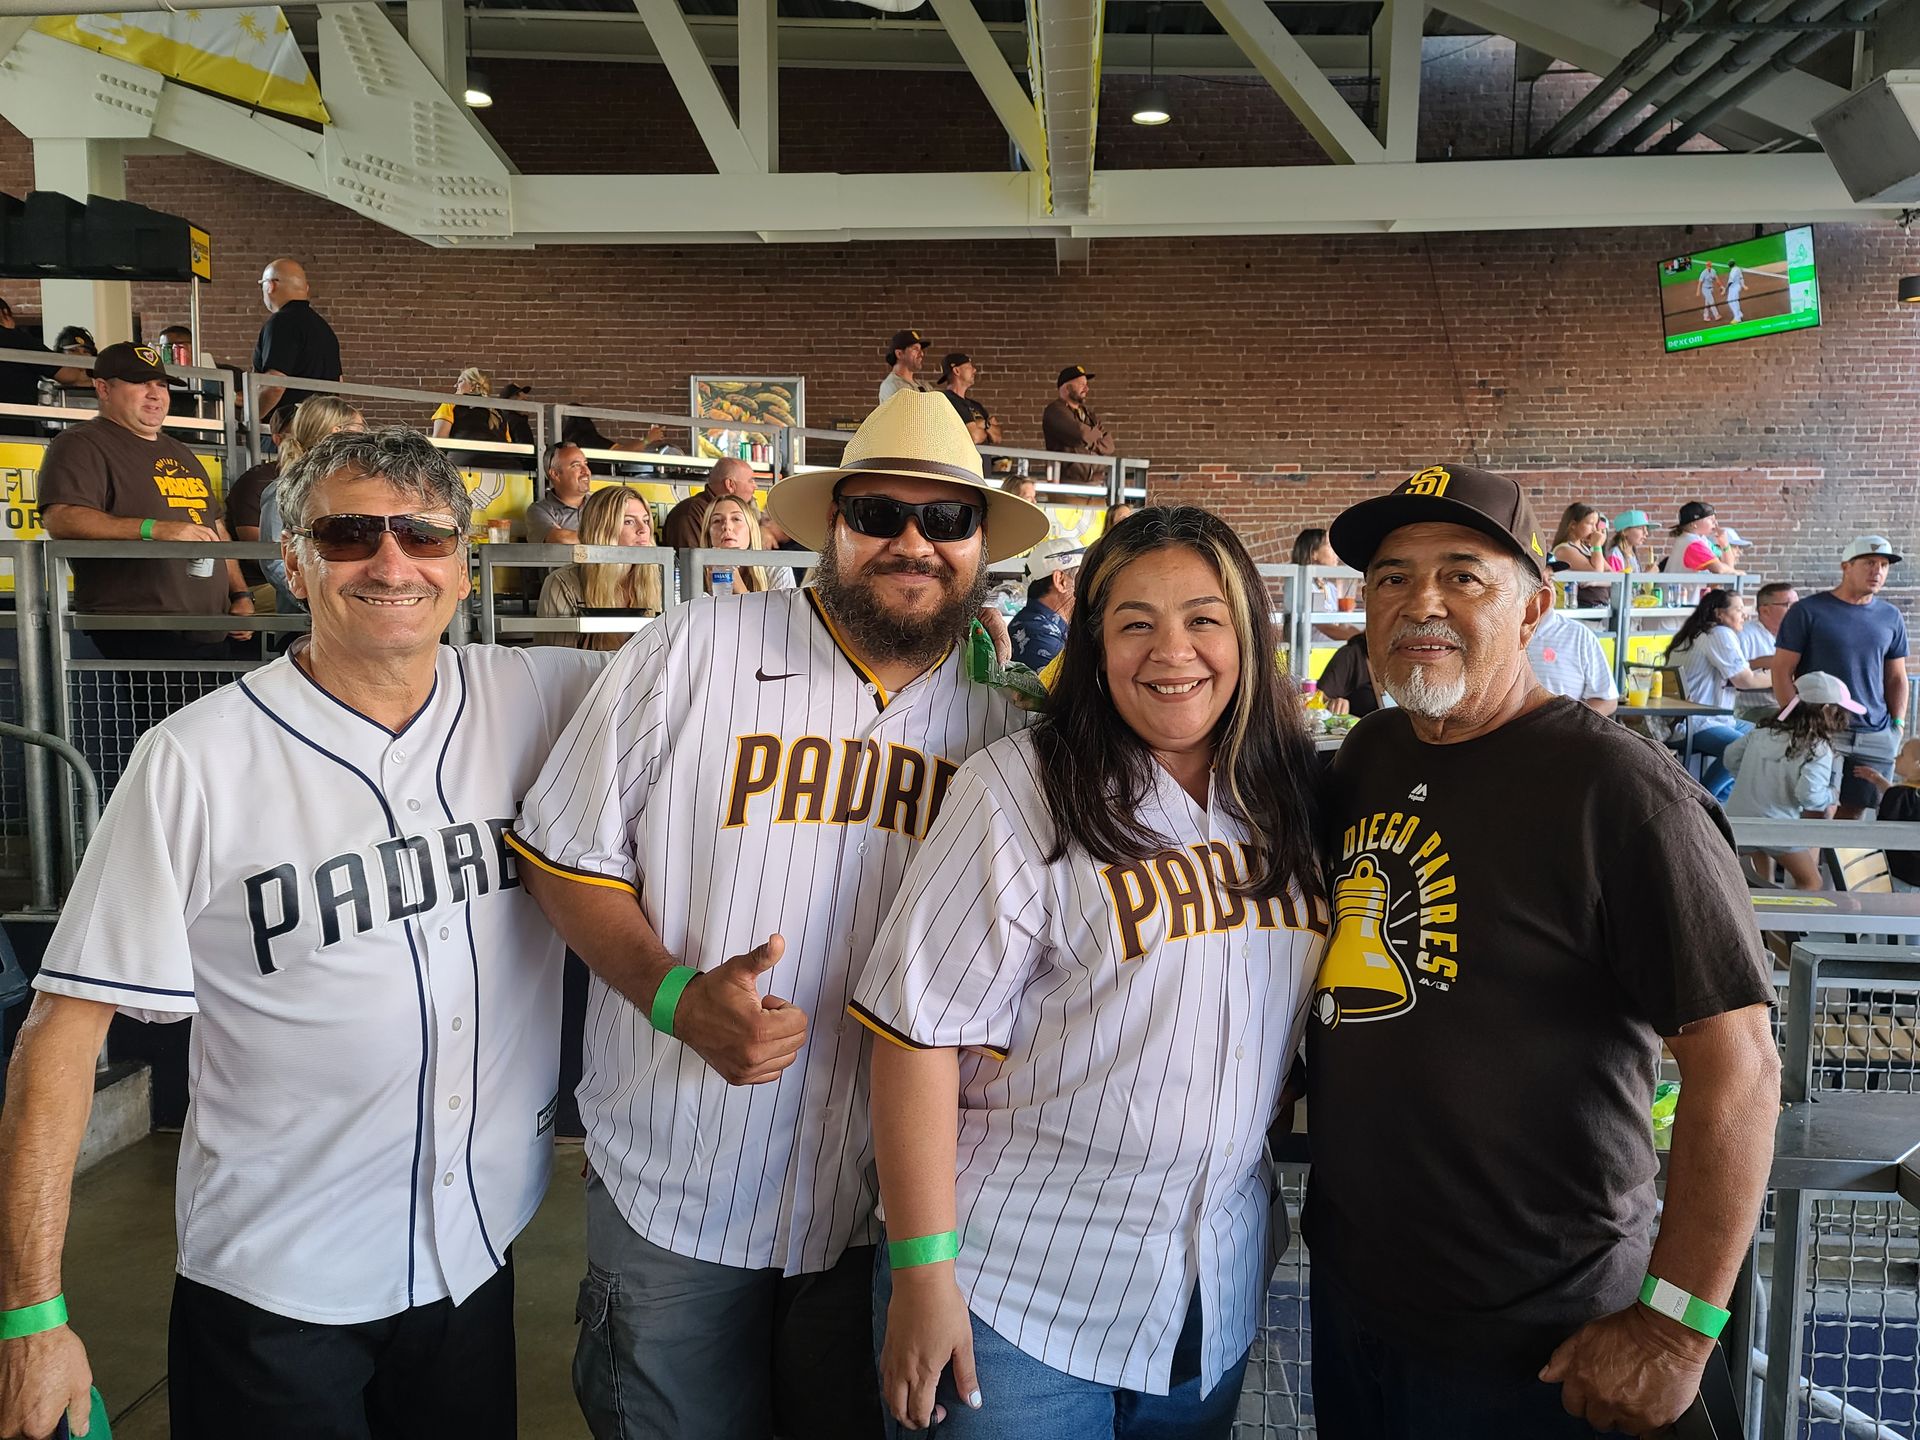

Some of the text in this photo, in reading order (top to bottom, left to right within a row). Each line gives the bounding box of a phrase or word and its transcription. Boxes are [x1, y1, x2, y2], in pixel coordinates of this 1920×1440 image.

[153, 476, 209, 498] PADRES
[1342, 812, 1420, 861] DIEGO
[1408, 830, 1458, 978] PADRES
